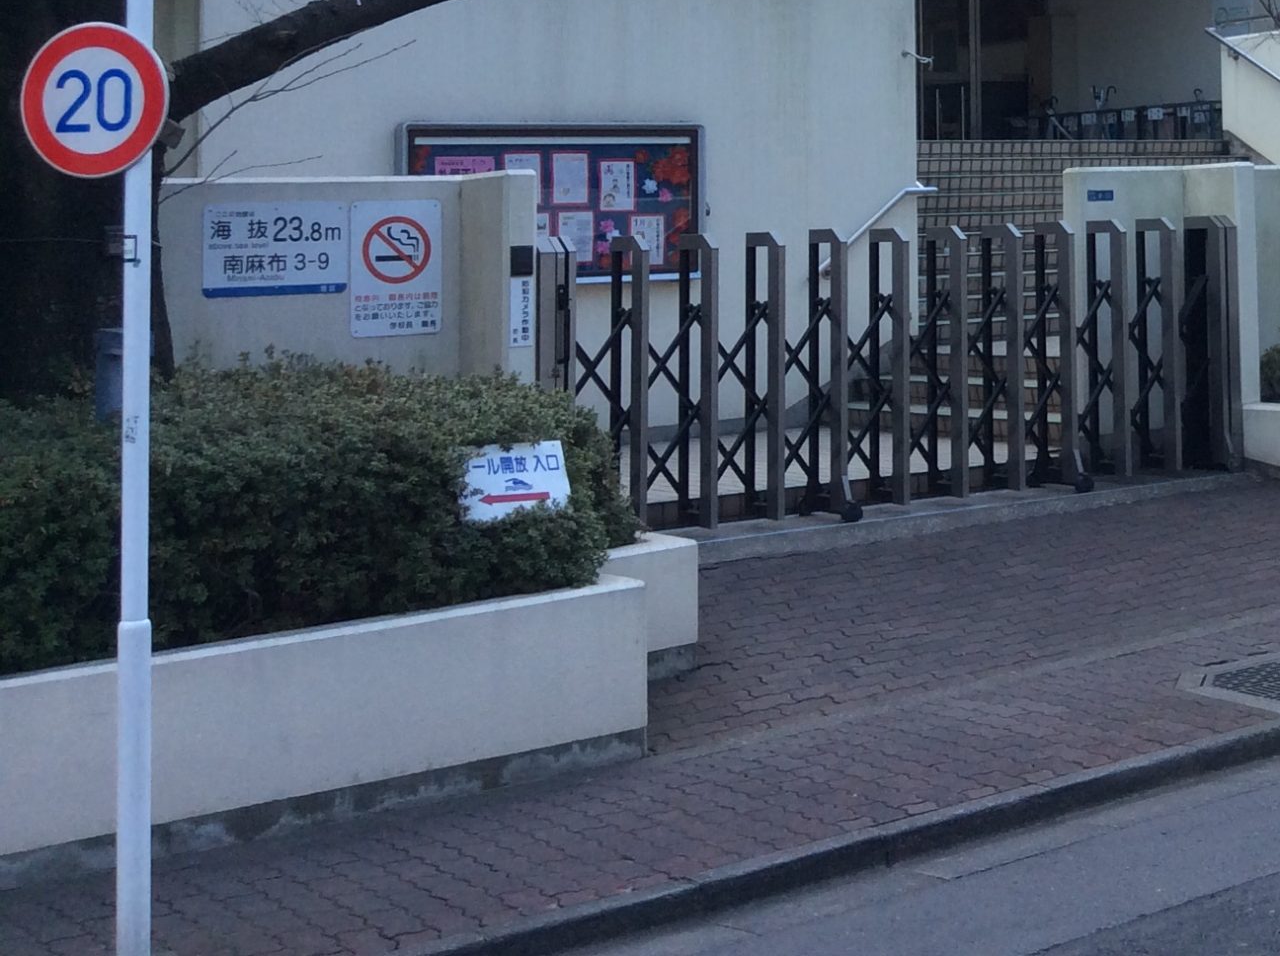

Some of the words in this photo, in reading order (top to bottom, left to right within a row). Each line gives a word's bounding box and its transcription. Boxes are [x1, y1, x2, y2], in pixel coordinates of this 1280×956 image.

[55, 68, 133, 133] 20
[273, 216, 342, 242] 23.8m
[223, 253, 287, 275] 南麻布
[294, 252, 330, 271] 3-9
[533, 454, 560, 473] 入口
